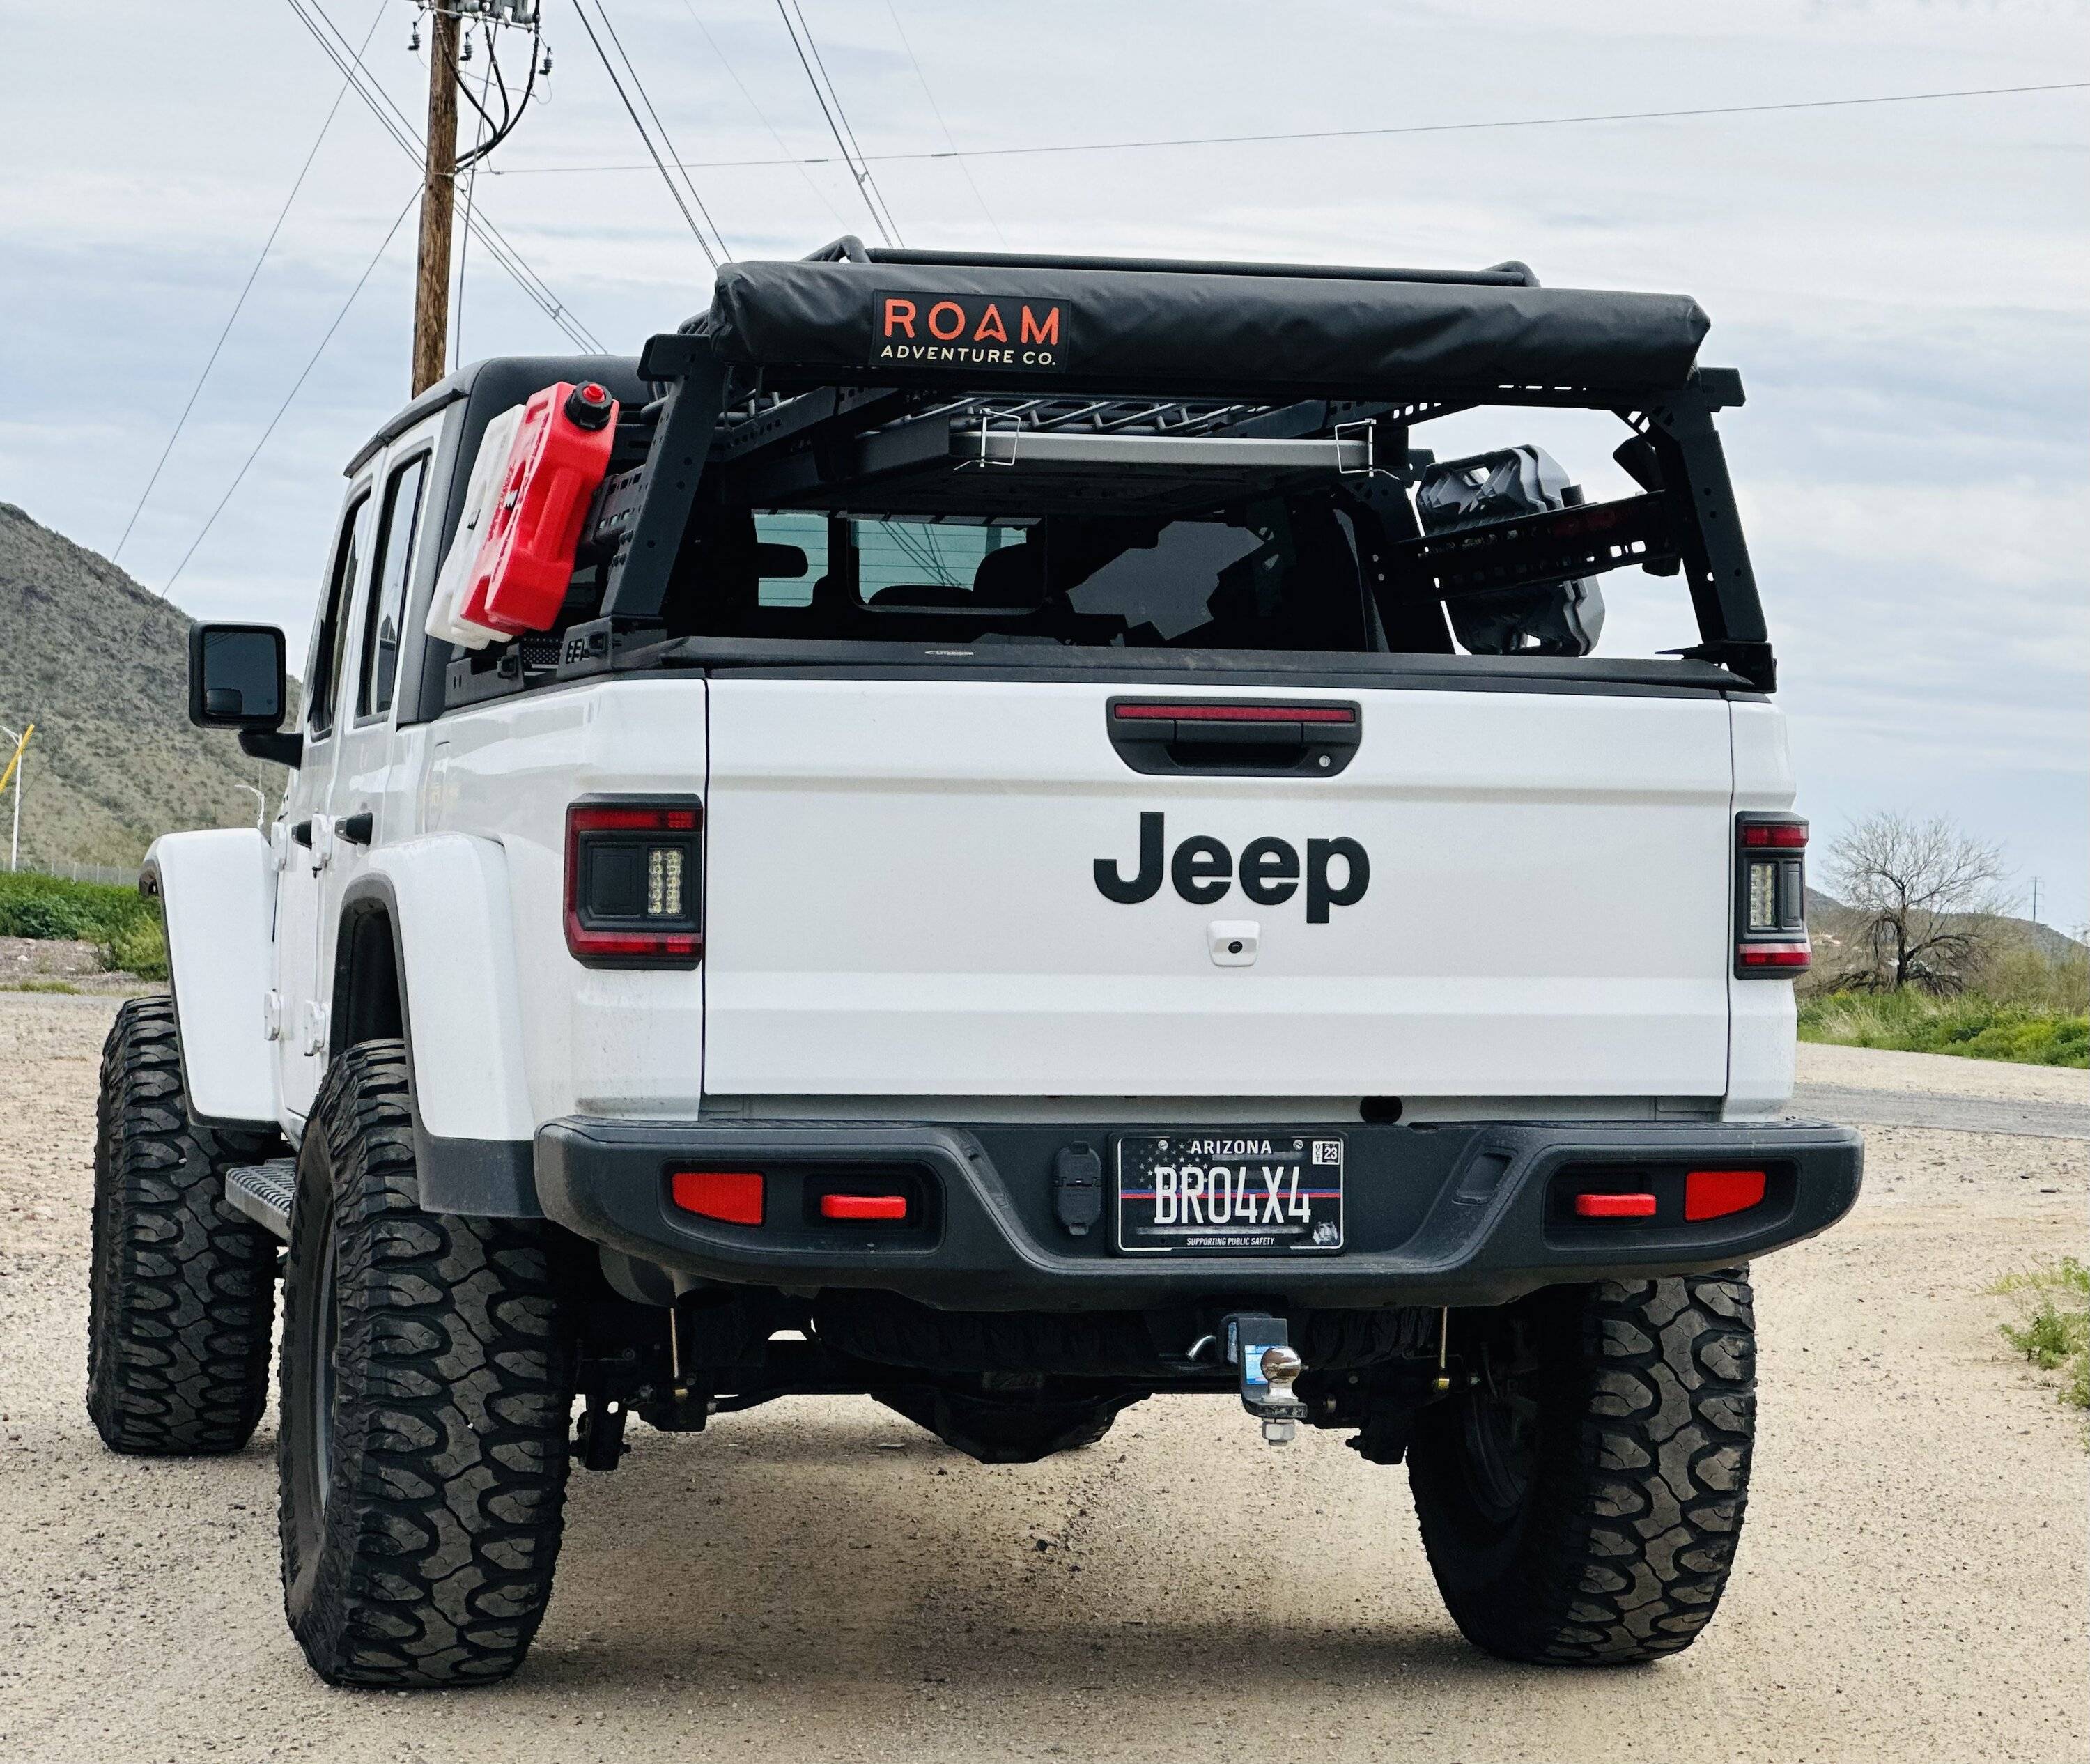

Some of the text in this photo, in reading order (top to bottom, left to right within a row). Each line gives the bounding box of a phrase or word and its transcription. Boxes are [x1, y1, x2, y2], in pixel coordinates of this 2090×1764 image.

[884, 298, 1060, 346] ROAM
[881, 346, 1056, 366] ADVENTURE CO.
[1094, 812, 1370, 923] Jeep
[1191, 1140, 1272, 1154] ARIZONA
[1324, 1147, 1337, 1159] 23
[1186, 1237, 1275, 1246] SUPPORTING PUBLIC SAFETY
